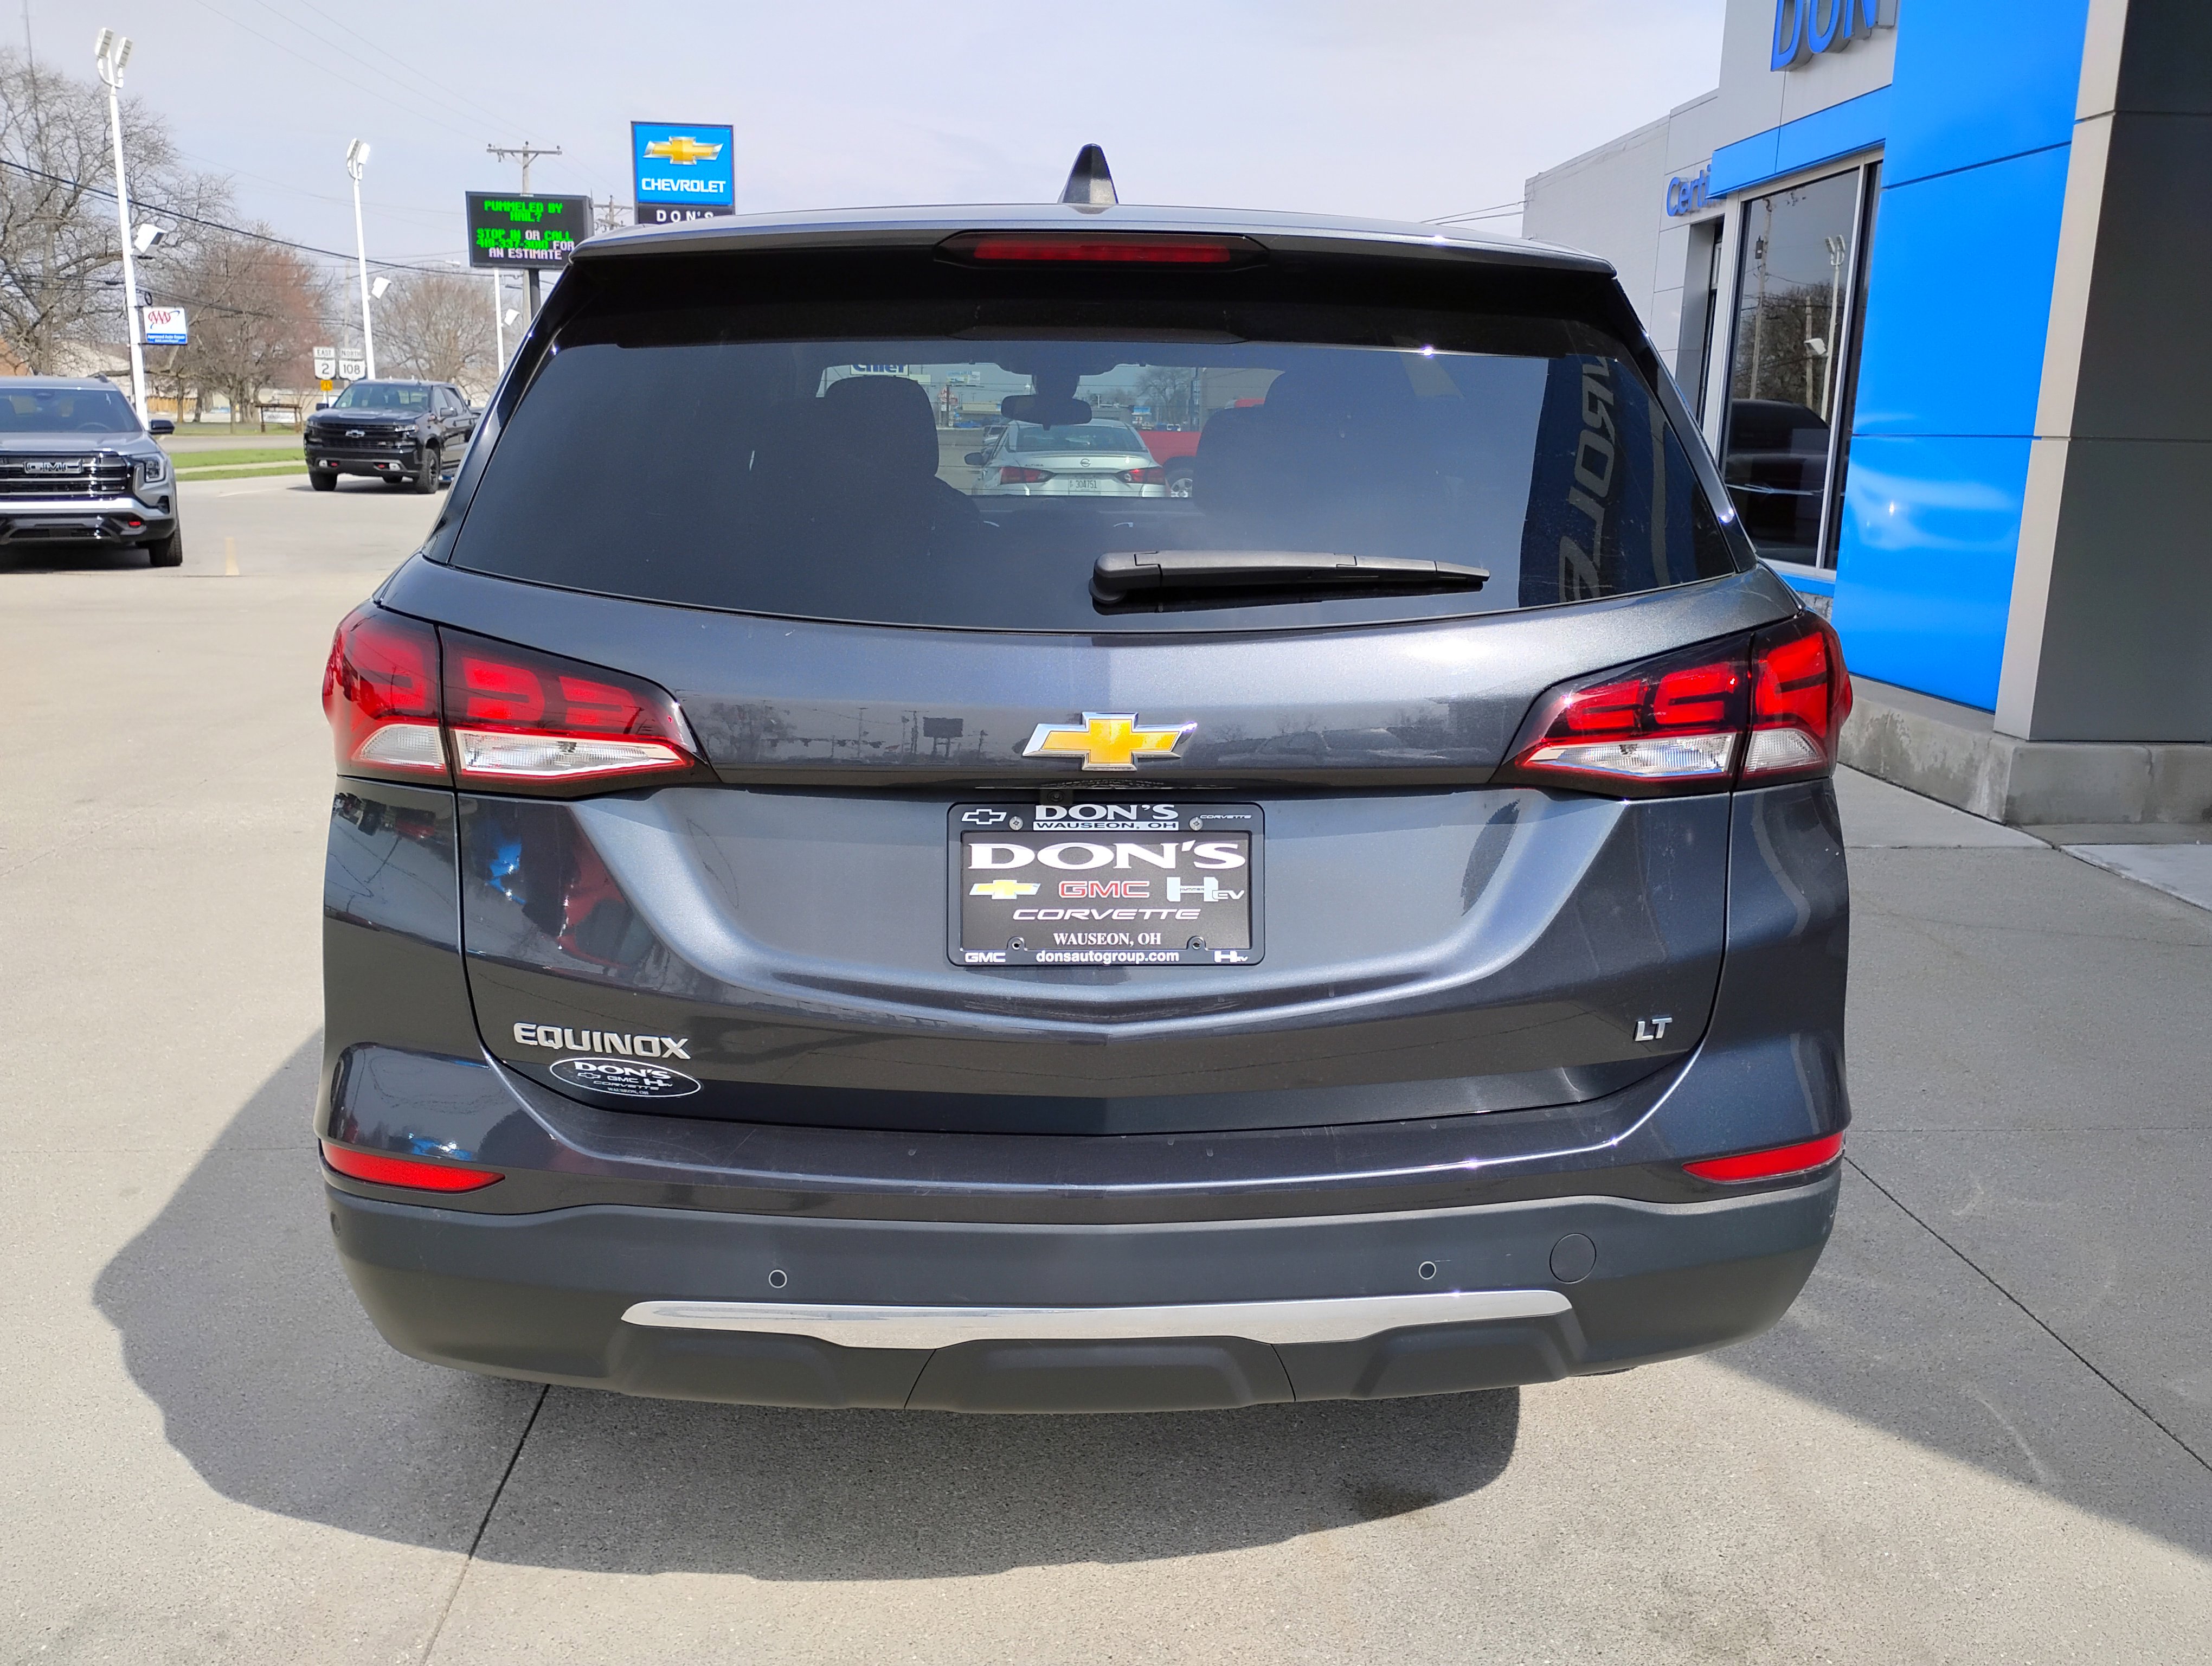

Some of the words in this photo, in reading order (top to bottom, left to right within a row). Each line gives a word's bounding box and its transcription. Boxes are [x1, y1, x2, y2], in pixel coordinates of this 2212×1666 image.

[641, 178, 726, 193] CHEVROLET
[1667, 164, 1712, 216] Certi
[484, 200, 544, 213] PUMMELED
[548, 203, 563, 214] BY
[510, 211, 542, 222] HAIL?
[477, 228, 505, 239] STOP
[510, 229, 521, 240] IN
[525, 230, 541, 240] OR
[544, 230, 573, 241] CALL
[553, 241, 575, 251] FOR
[489, 247, 504, 258] AN
[508, 248, 562, 260] ESTIMATE
[148, 311, 171, 324] AAA
[321, 363, 330, 375] 2
[344, 364, 360, 375] 108
[1075, 480, 1097, 489] 304751
[1035, 804, 1179, 821] DON'S
[968, 840, 1246, 870] DON'S
[1058, 880, 1150, 899] GMC
[1012, 908, 1201, 920] CORVETTE
[1053, 933, 1134, 947] WAUSEON,
[1137, 933, 1161, 945] OH
[964, 952, 1006, 963] GMC
[1036, 950, 1179, 964] donsautogroup.com
[1635, 1017, 1672, 1041] LT
[513, 1022, 691, 1060] EQUINOX
[574, 1061, 671, 1079] DON'S
[593, 1081, 660, 1091] CORVETTE
[607, 1075, 639, 1084] GMC
